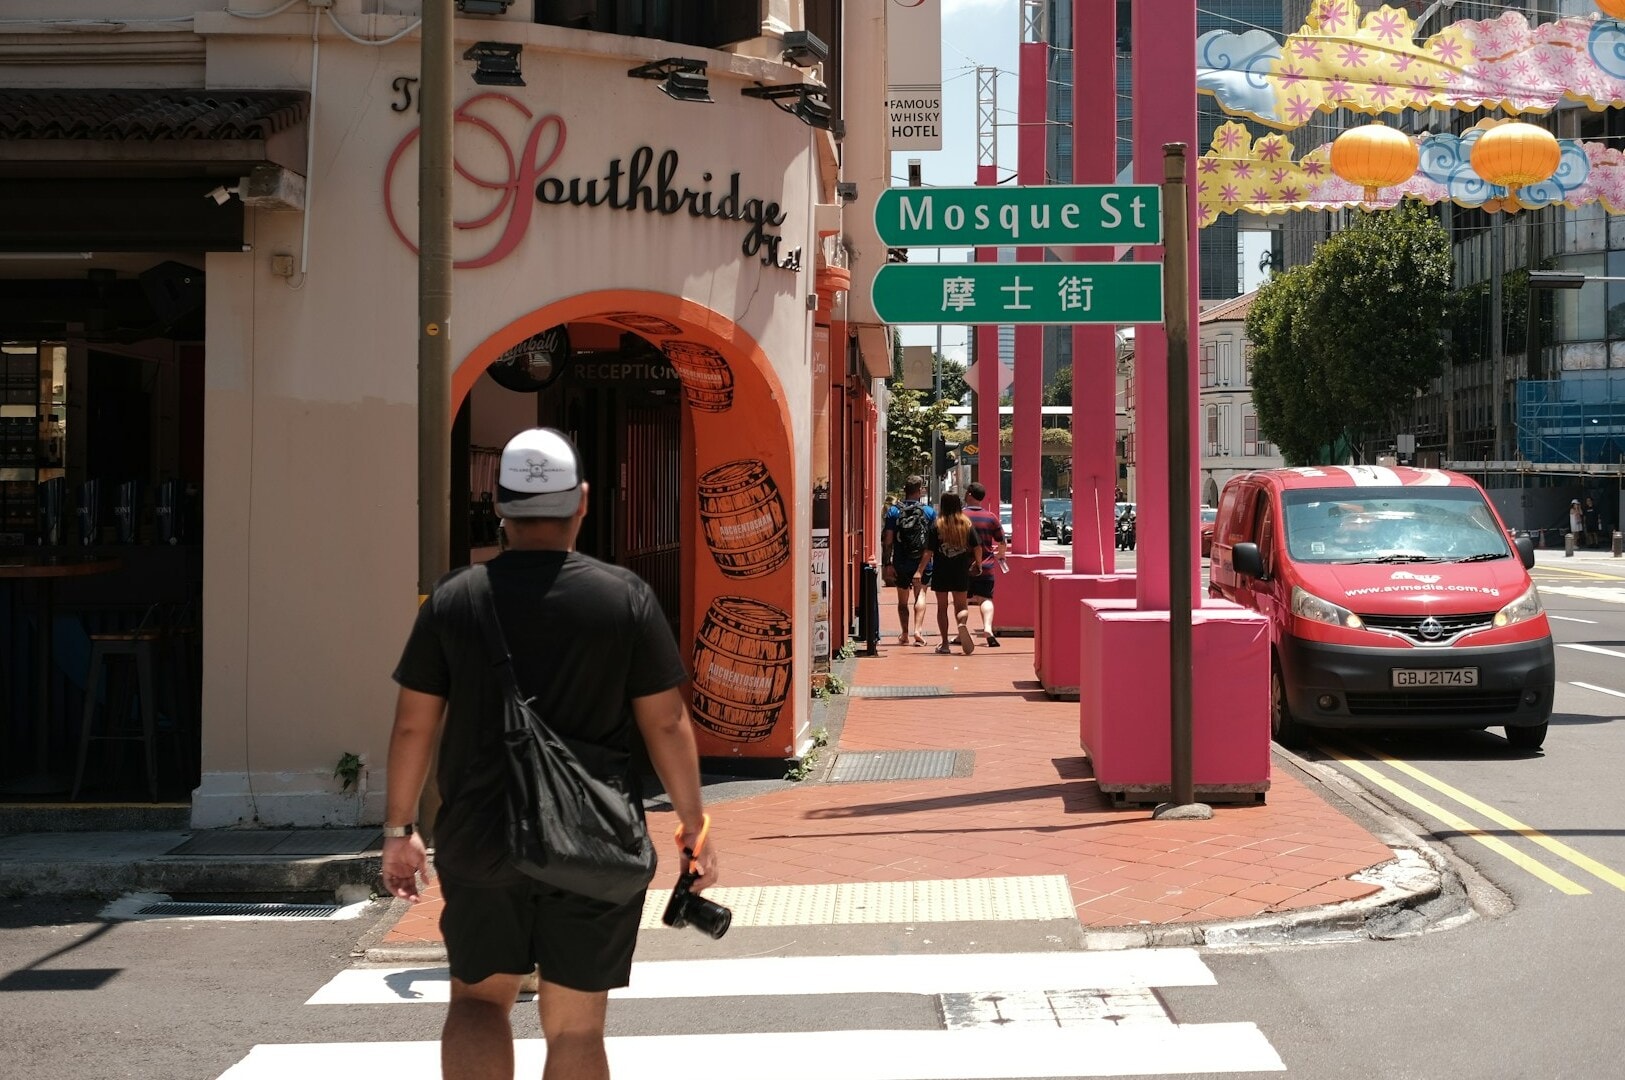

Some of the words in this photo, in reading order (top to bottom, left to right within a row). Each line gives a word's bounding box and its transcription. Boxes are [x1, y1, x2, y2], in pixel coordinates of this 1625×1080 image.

[890, 99, 940, 109] FAMOUS
[890, 112, 940, 122] WHISKY
[891, 125, 939, 138] HOTEL
[384, 92, 787, 269] Southbridge
[899, 195, 1081, 238] Mosque
[1099, 192, 1147, 230] St
[940, 275, 1095, 313] 摩士街
[574, 363, 680, 380] RECEPTION
[719, 512, 773, 536] AUCHENTOSHAN
[1345, 583, 1500, 597] www.avmedia.com.sg
[708, 662, 774, 689] AUCHENTOSHAN
[1397, 671, 1474, 685] GBJ2174S
